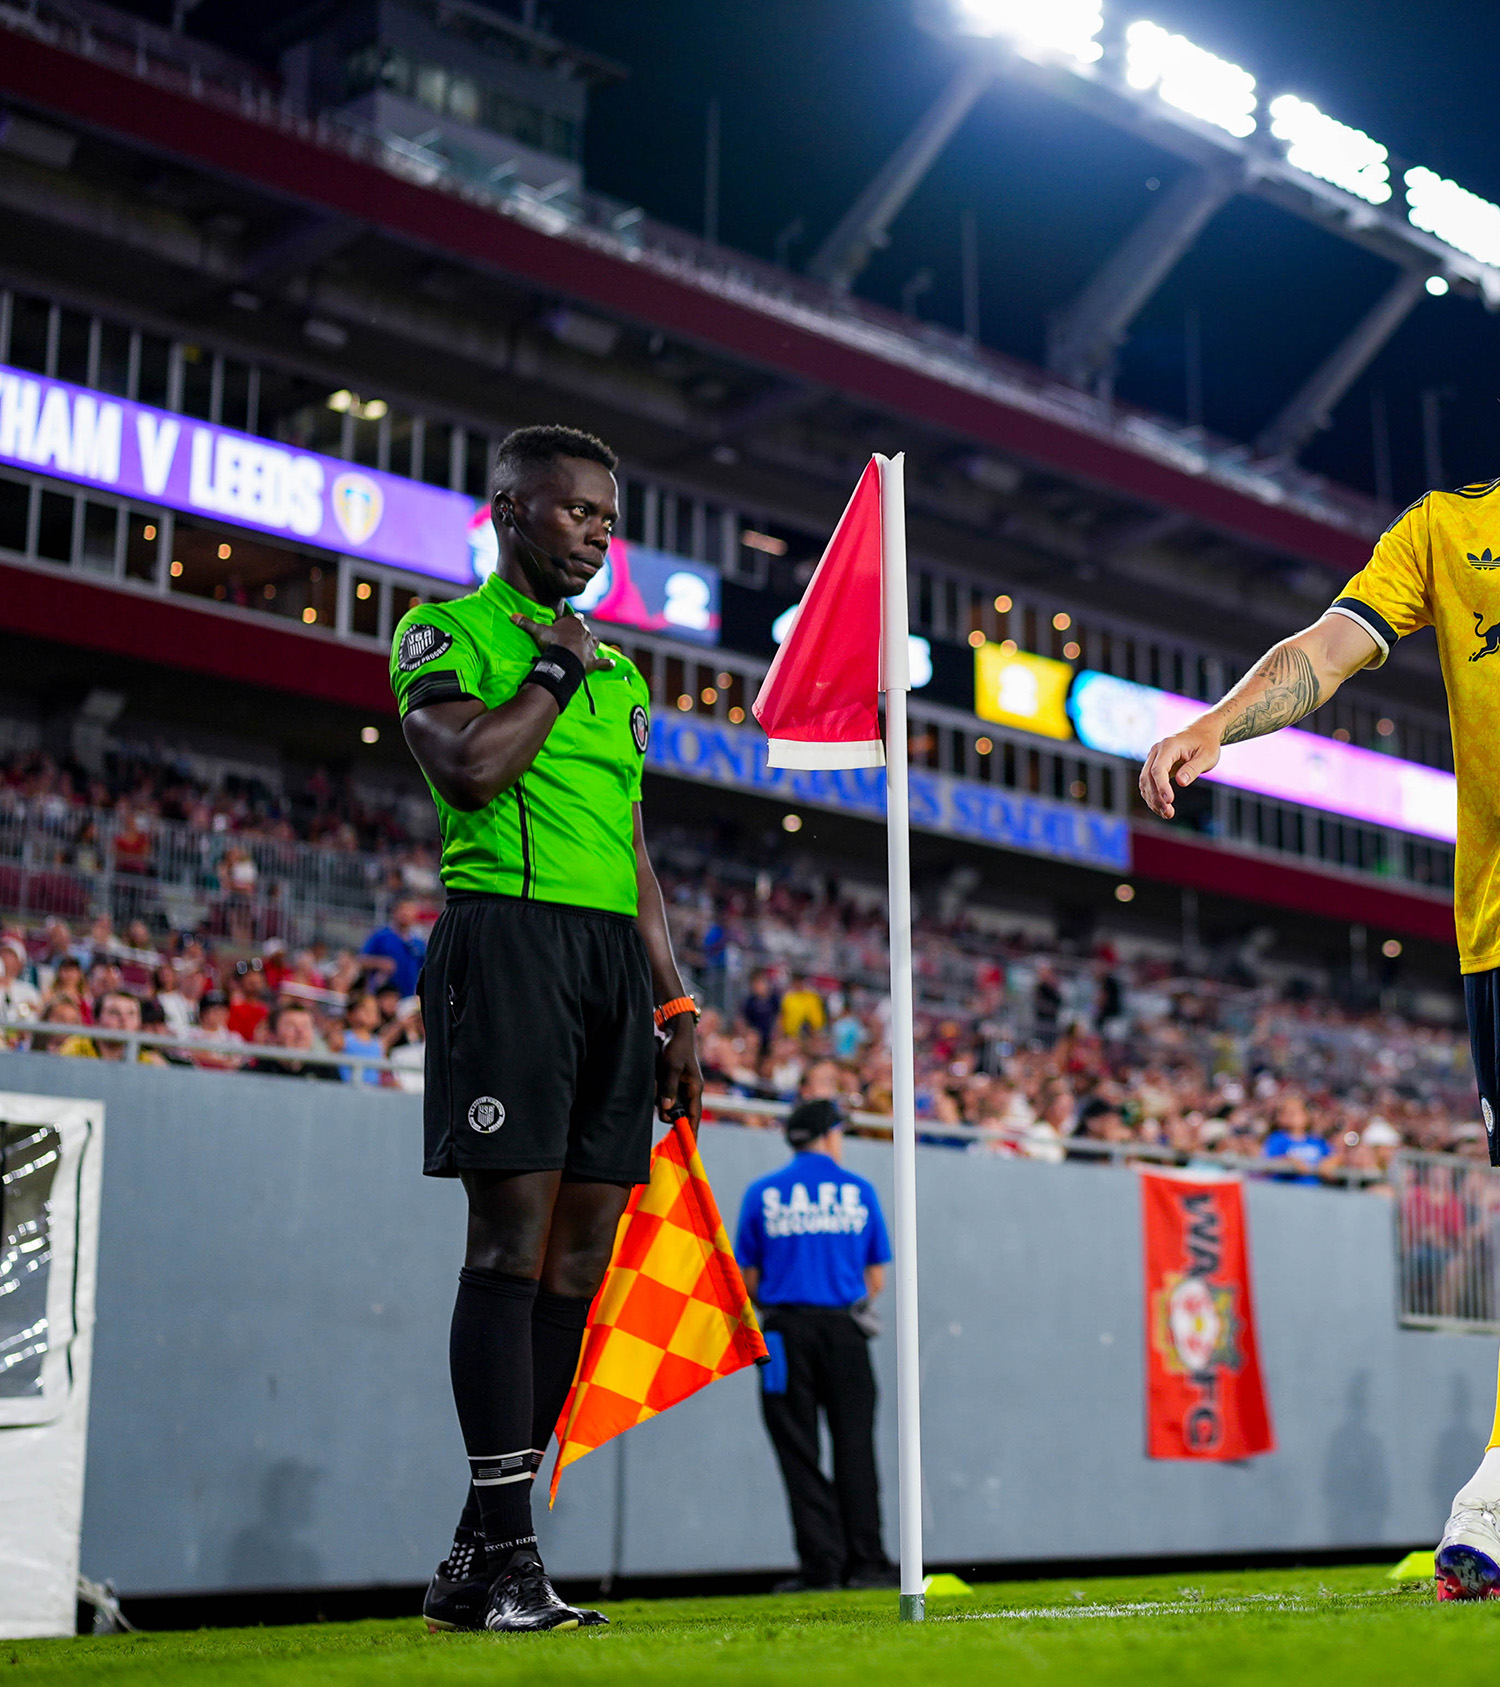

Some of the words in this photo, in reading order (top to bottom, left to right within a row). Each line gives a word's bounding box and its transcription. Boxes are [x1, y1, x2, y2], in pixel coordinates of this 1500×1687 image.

[0, 371, 123, 484] HAM
[136, 411, 181, 496] V
[189, 428, 325, 537] LEEDS
[663, 571, 711, 631] 2
